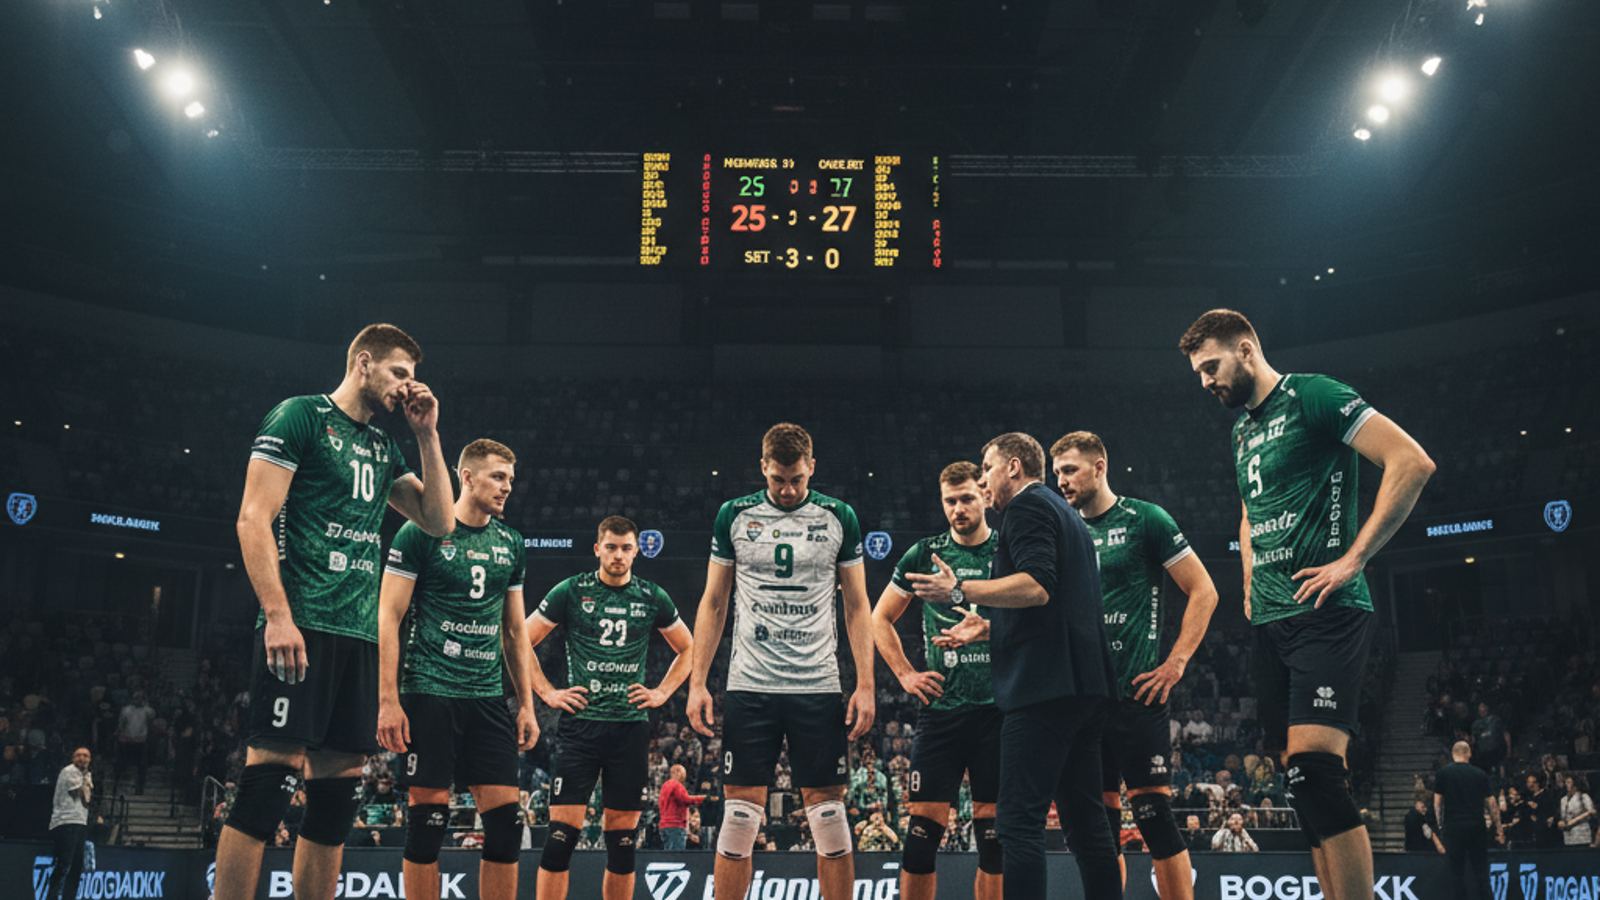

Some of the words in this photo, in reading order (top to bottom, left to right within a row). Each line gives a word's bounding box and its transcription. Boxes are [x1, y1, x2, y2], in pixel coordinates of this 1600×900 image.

[739, 175, 765, 197] 25
[730, 204, 766, 232] 25
[822, 205, 857, 232] 27
[825, 247, 840, 269] 0
[349, 459, 375, 502] 10
[774, 543, 794, 579] 9
[469, 564, 487, 599] 3
[271, 696, 290, 728] 9
[406, 753, 418, 776] 9
[723, 751, 733, 775] 9
